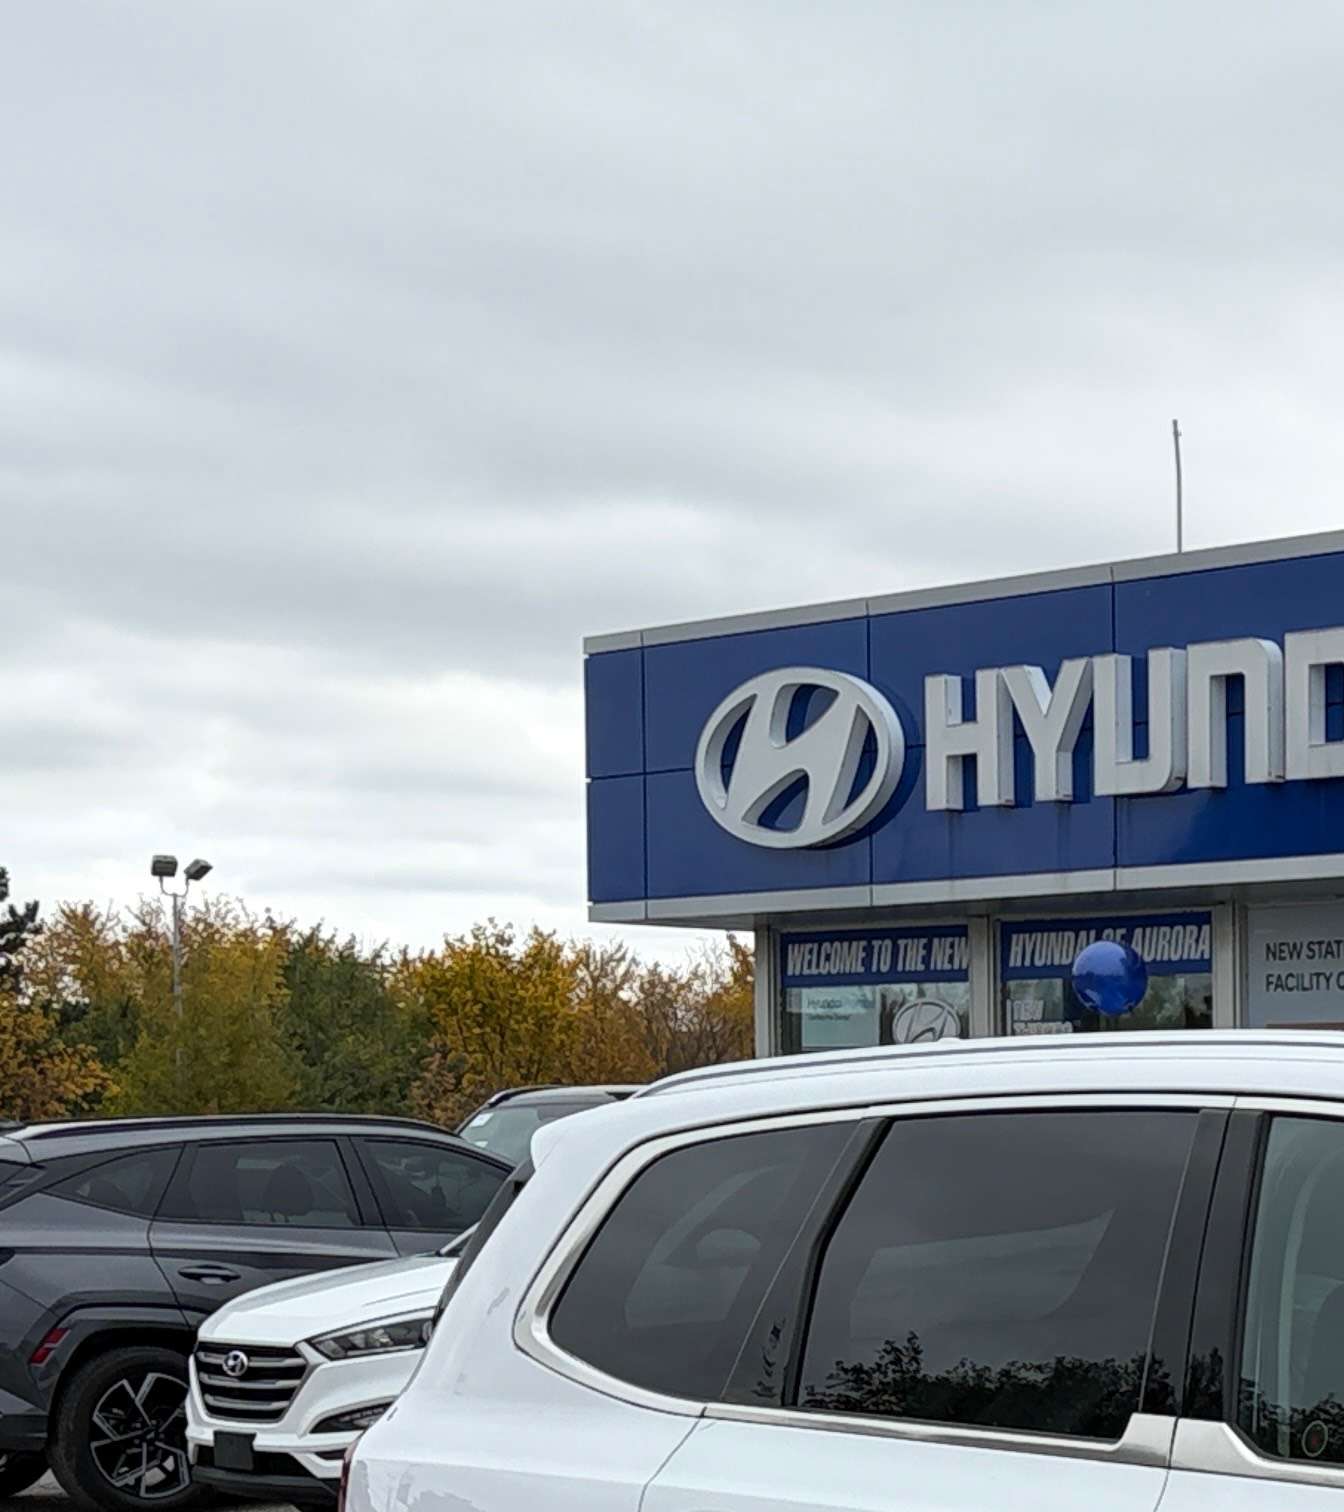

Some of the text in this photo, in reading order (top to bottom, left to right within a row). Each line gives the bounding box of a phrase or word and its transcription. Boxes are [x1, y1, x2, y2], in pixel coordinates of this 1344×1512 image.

[787, 937, 969, 976] WELCOME TO THE NEW
[1131, 924, 1211, 962] AURORA
[1265, 942, 1303, 961] NEW
[1265, 971, 1333, 992] FACILITY
